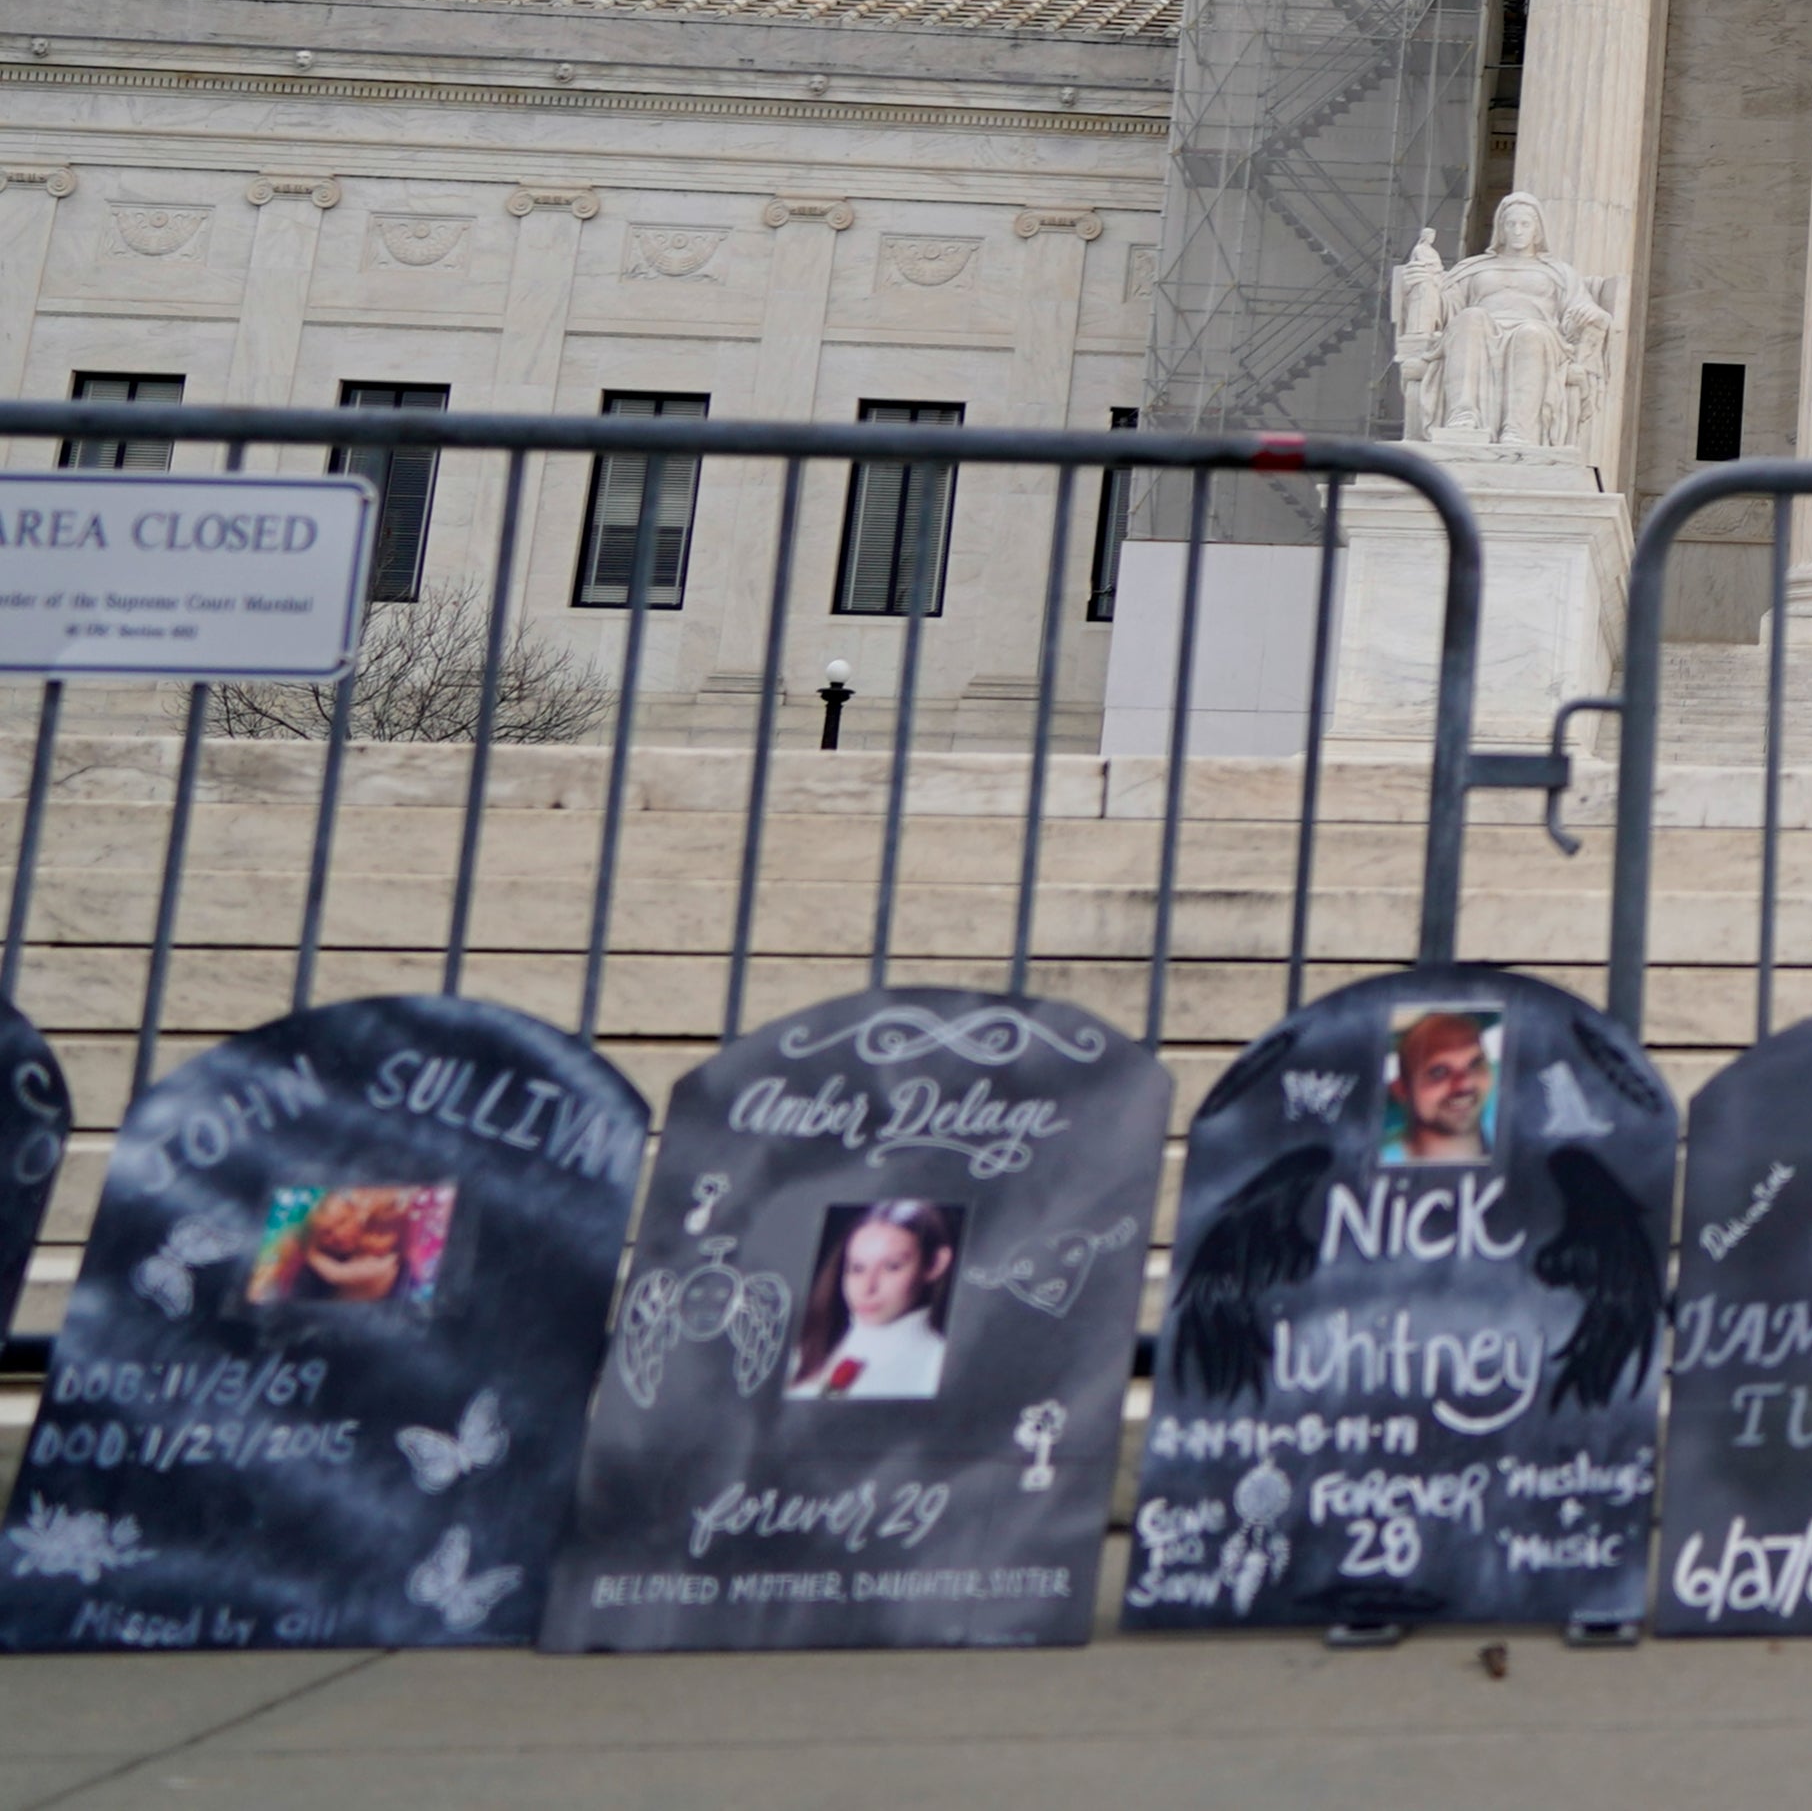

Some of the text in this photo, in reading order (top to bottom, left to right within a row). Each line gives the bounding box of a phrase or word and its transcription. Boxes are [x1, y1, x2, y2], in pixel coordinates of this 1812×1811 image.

[131, 512, 319, 552] CLOSED
[106, 593, 180, 612] Supreme
[185, 595, 235, 612] Court
[137, 1055, 328, 1192] JOHN
[367, 1048, 629, 1188] SULLIVAN
[729, 1075, 1069, 1149] Amber Delage
[1273, 1307, 1545, 1434] Whitney
[690, 1482, 950, 1557] forever 29
[1339, 1515, 1421, 1577] 28
[591, 1571, 719, 1609] BELOVED
[69, 1600, 201, 1647] Missed
[212, 1606, 255, 1646] by
